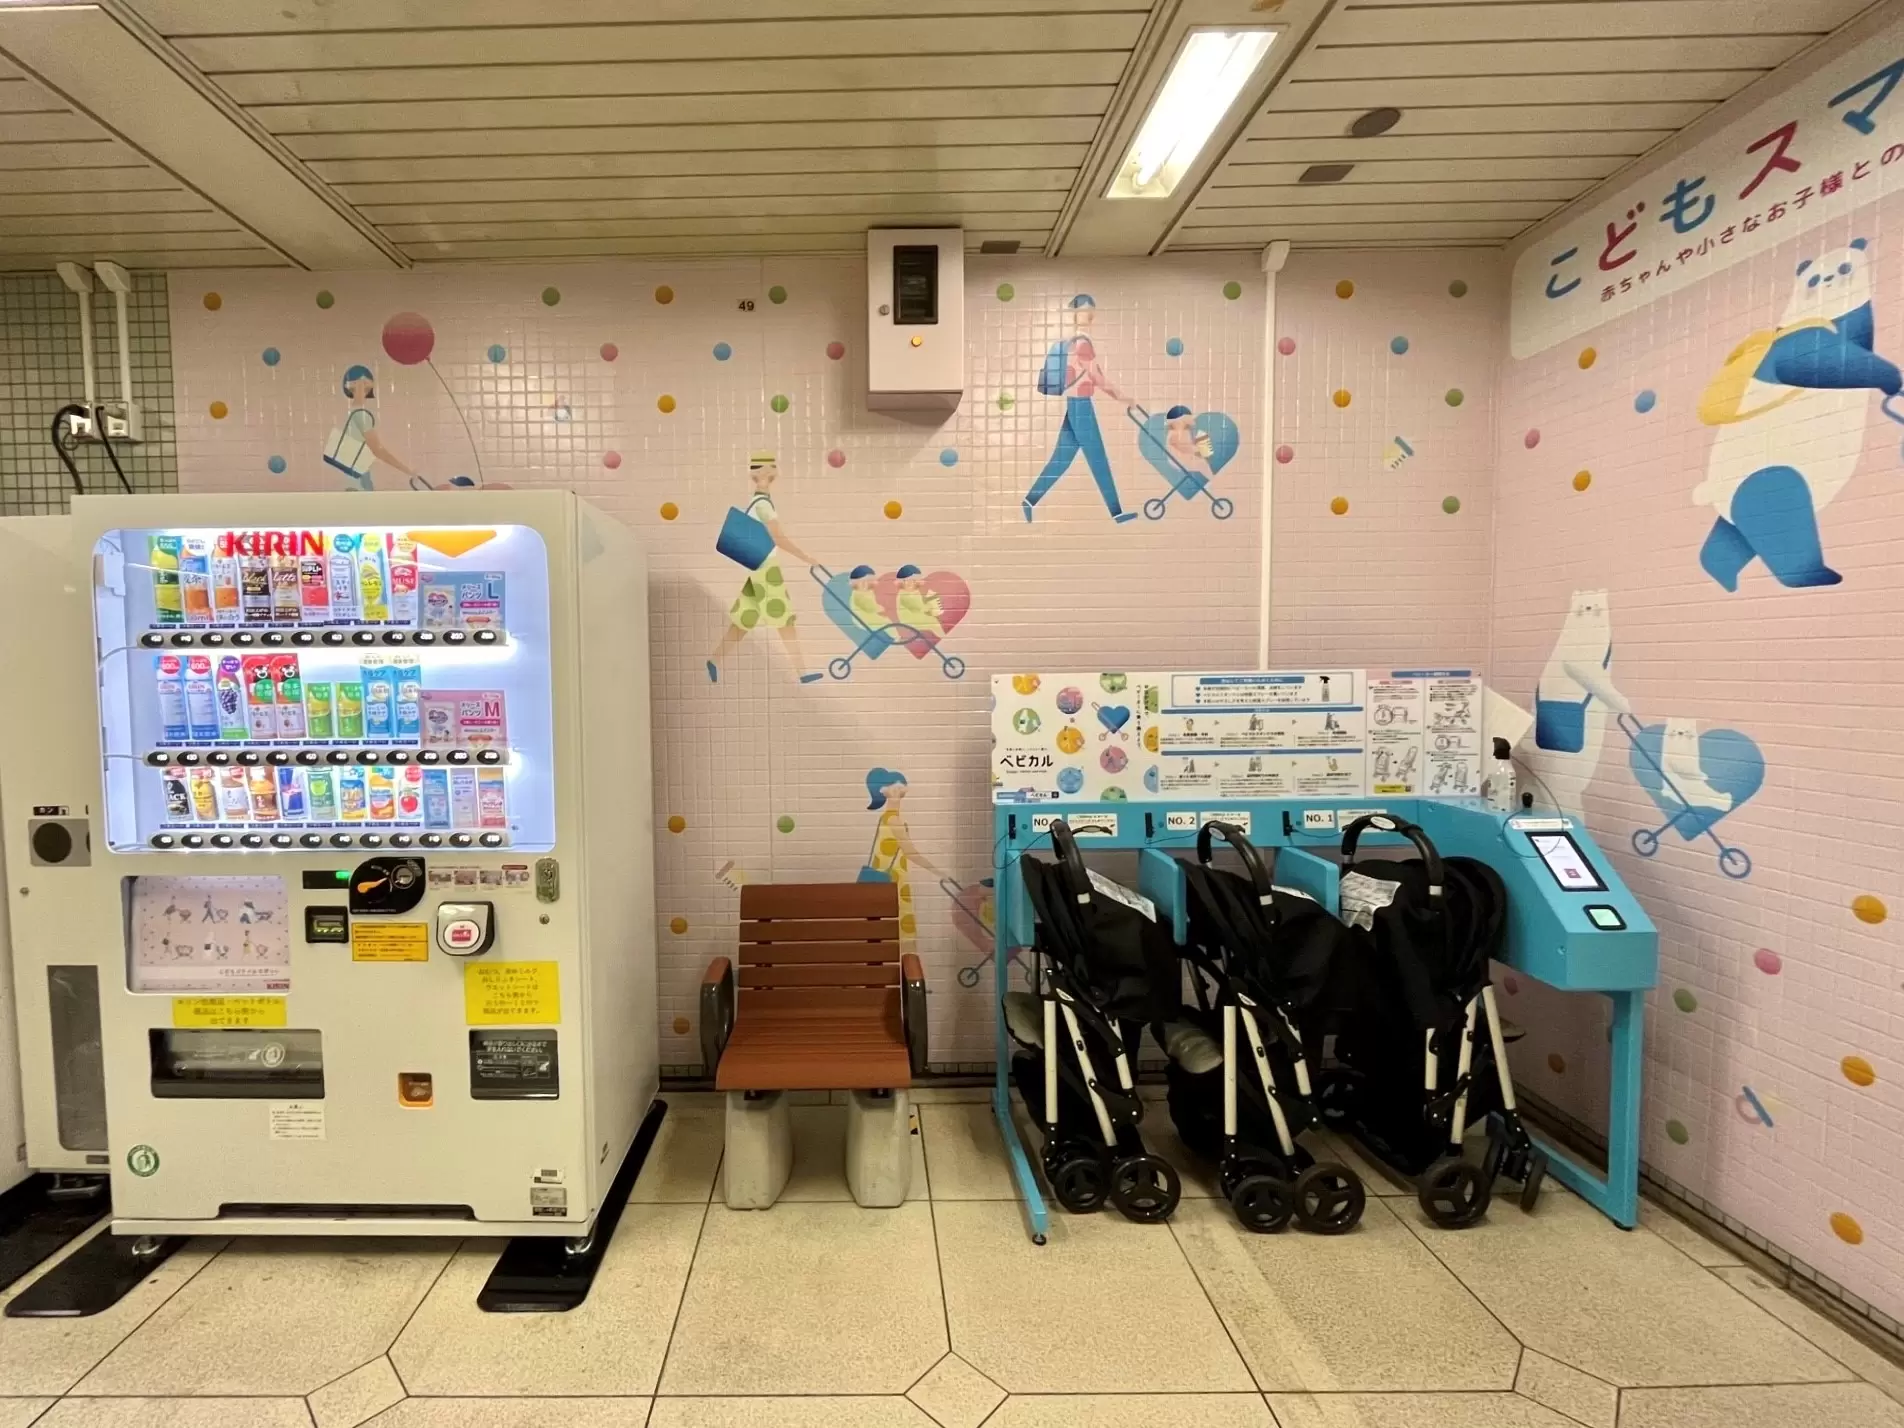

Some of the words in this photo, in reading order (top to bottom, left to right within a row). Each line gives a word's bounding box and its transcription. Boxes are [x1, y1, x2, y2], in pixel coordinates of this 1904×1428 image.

[1601, 143, 1904, 302] 赤ちゃんや小さなお子様との
[738, 300, 755, 312] 49
[226, 531, 324, 556] KIRIN
[488, 583, 499, 599] L
[485, 702, 500, 717] M
[1000, 755, 1054, 768] ベビカル
[1168, 817, 1187, 825] NO.
[1189, 816, 1195, 825] 2
[1306, 815, 1327, 823] NO.
[1328, 814, 1333, 822] 1
